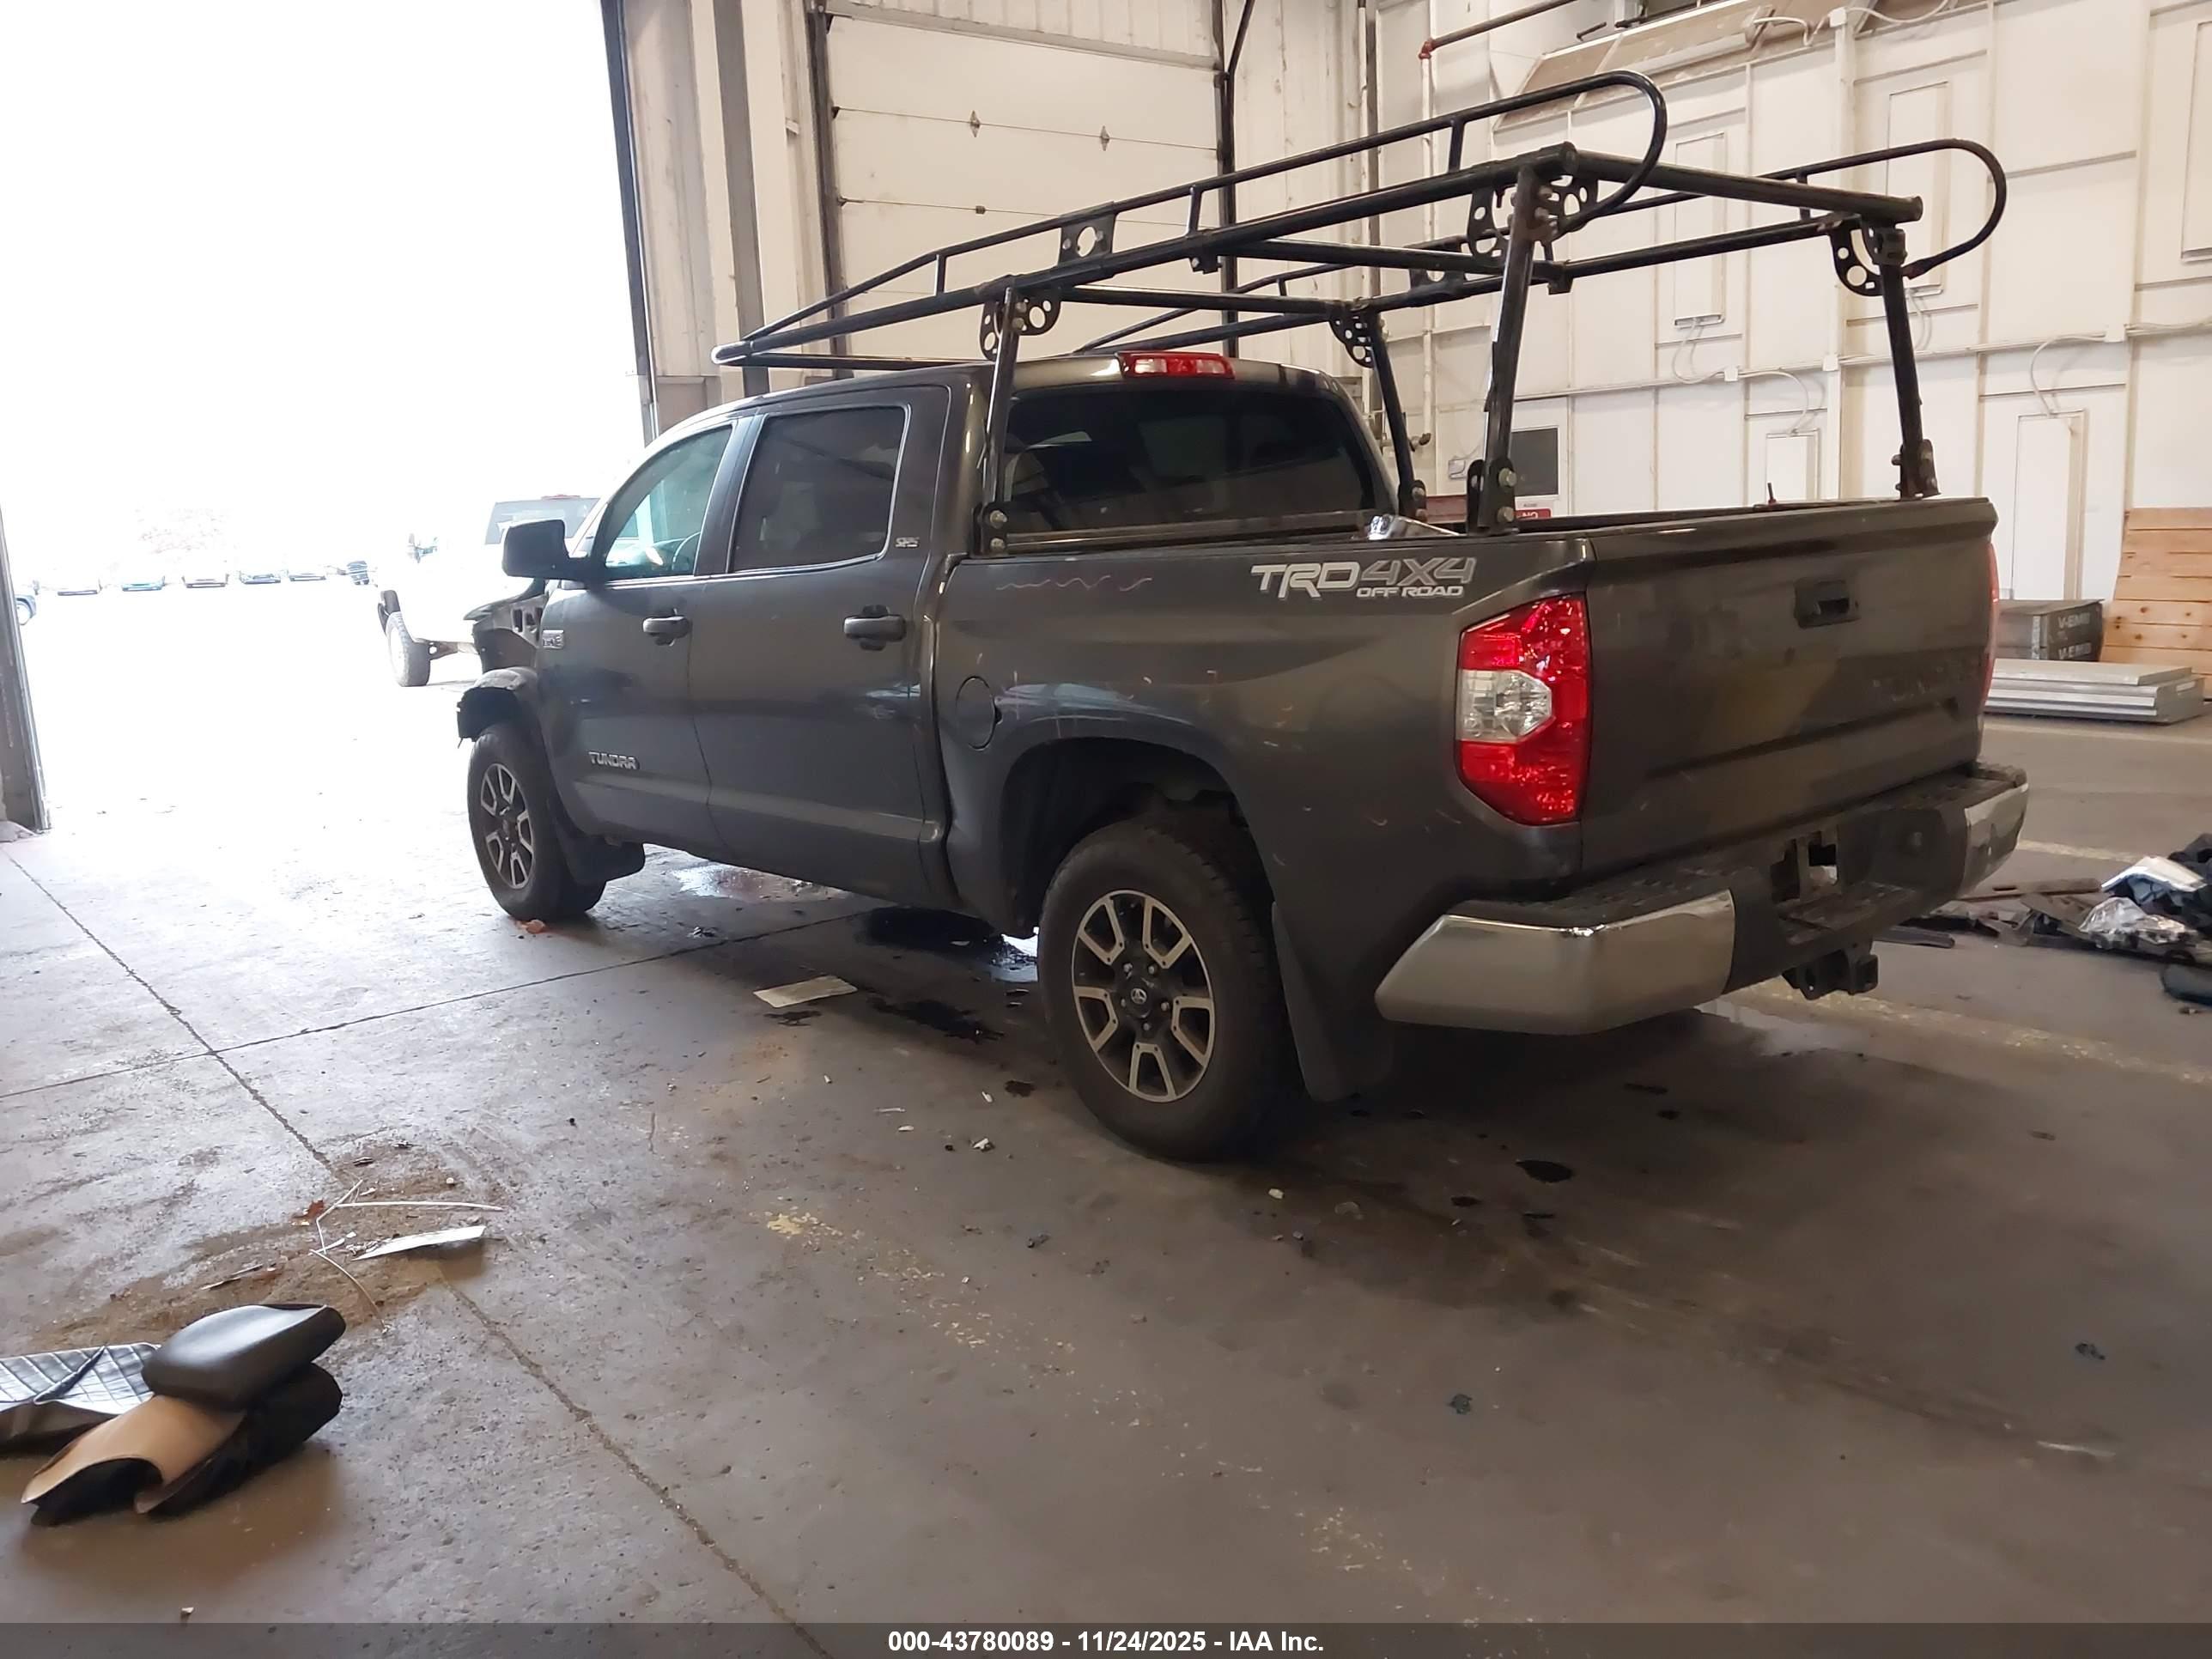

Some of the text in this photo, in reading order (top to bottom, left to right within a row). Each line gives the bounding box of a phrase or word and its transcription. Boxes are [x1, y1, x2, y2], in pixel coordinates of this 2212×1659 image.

[1250, 557, 1477, 598] TRD 4X4
[1356, 586, 1464, 598] OFF ROAD
[588, 750, 638, 770] TUNDRA
